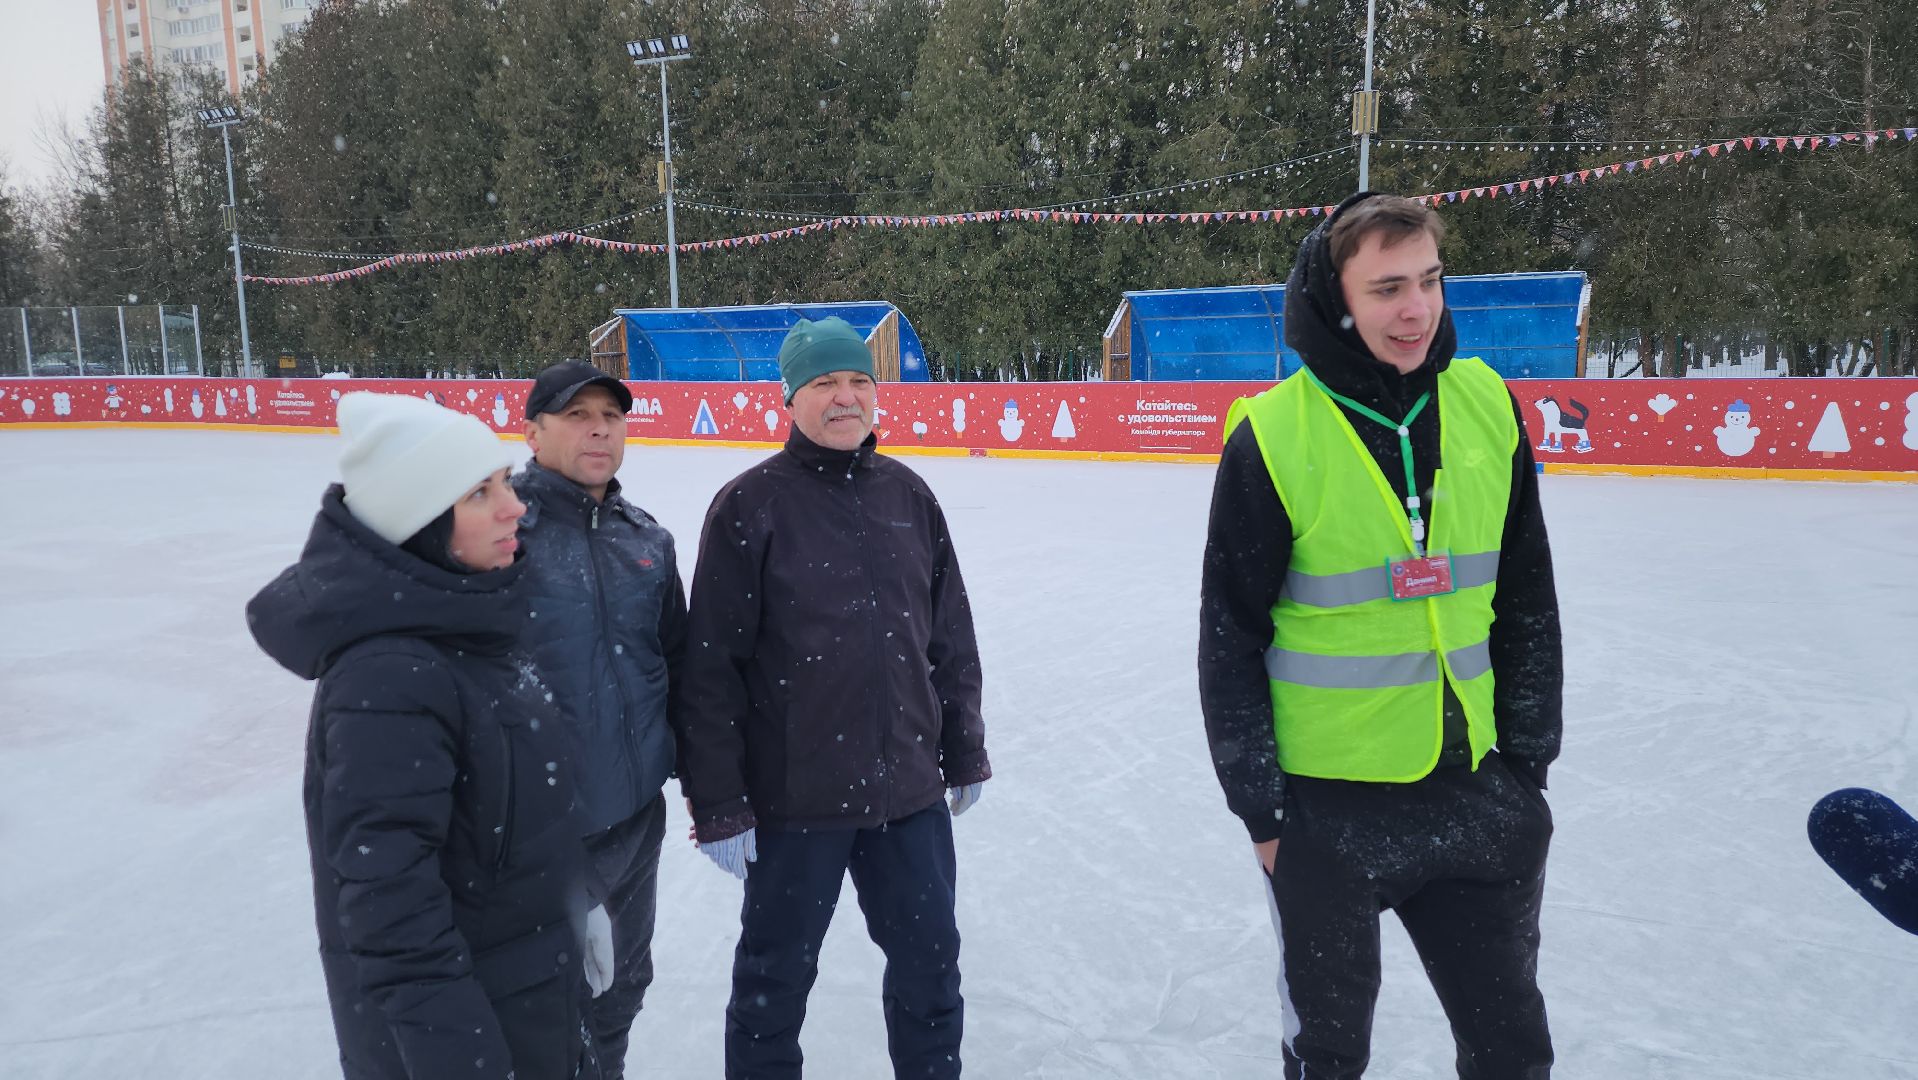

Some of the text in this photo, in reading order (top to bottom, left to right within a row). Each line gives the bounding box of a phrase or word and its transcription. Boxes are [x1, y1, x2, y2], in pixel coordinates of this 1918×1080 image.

[627, 397, 663, 415] МА
[1136, 399, 1198, 411] Катайтесь
[1117, 414, 1217, 425] с удовольствием
[1130, 428, 1206, 437] Команда губернатора
